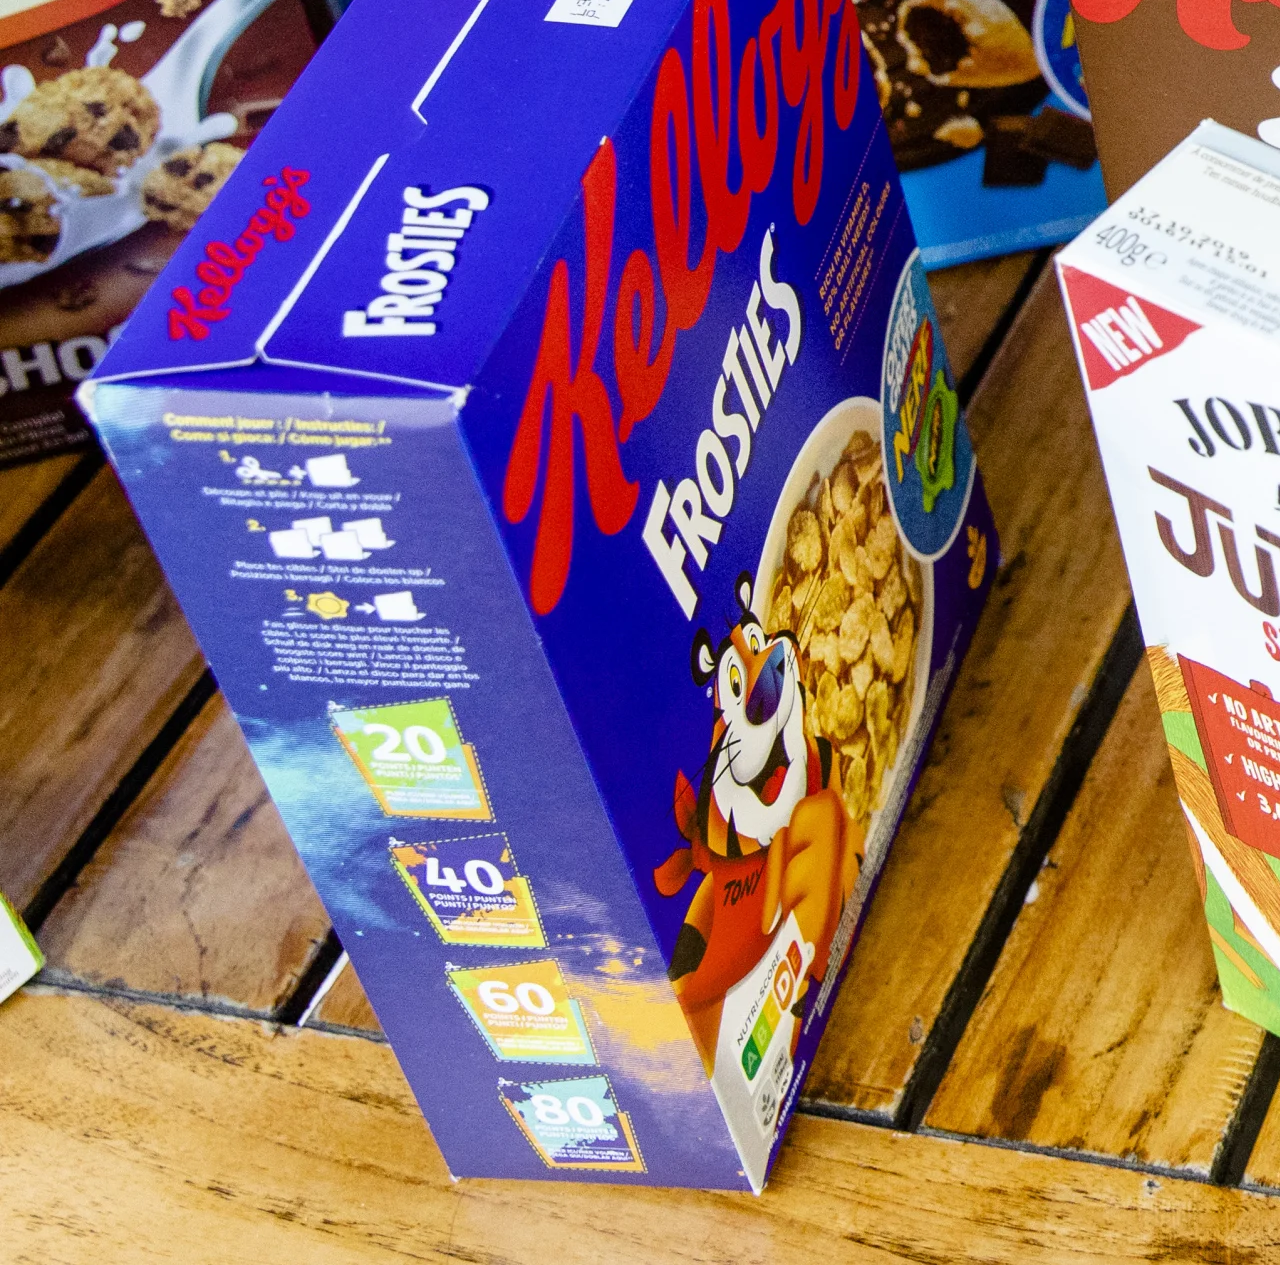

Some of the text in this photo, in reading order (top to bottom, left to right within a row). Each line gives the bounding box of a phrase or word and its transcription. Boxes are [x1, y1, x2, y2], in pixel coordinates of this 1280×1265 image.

[166, 165, 312, 341] Kellogg's
[342, 185, 491, 338] FROSTIES
[1096, 224, 1149, 266] 400g
[1079, 294, 1164, 372] NEW
[641, 227, 803, 622] FROSTIES
[1223, 692, 1247, 723] NO
[362, 723, 447, 764] 20
[425, 856, 504, 895] 40
[723, 865, 764, 910] TONY
[429, 893, 467, 902] POINTS
[477, 981, 554, 1016] 60
[735, 949, 782, 1047] NUTRI-SCORE
[530, 1094, 602, 1130] 80
